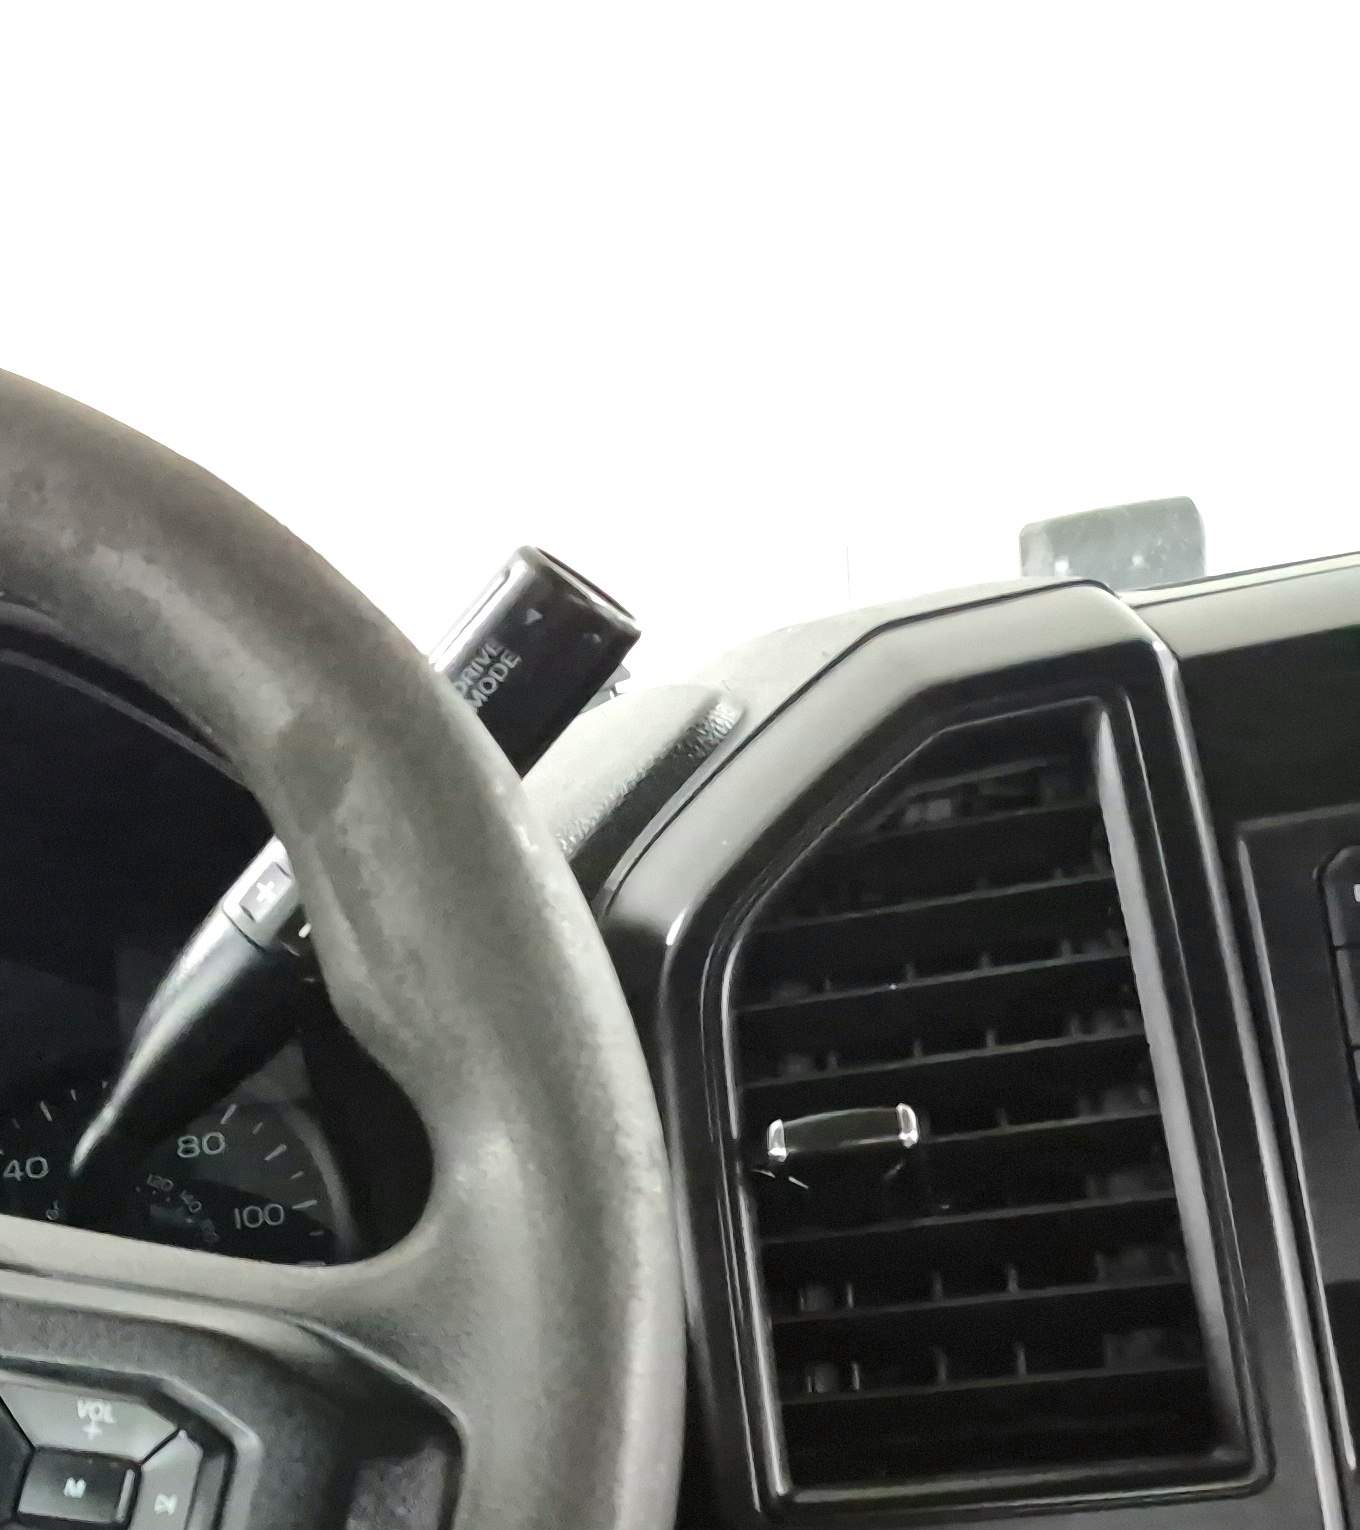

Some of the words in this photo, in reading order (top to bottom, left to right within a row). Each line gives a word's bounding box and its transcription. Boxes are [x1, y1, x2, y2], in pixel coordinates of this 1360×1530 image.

[469, 648, 522, 708] MODE
[176, 1130, 228, 1160] 80
[0, 1154, 50, 1183] 40
[232, 1201, 287, 1232] 100
[76, 1399, 116, 1425] VOL
